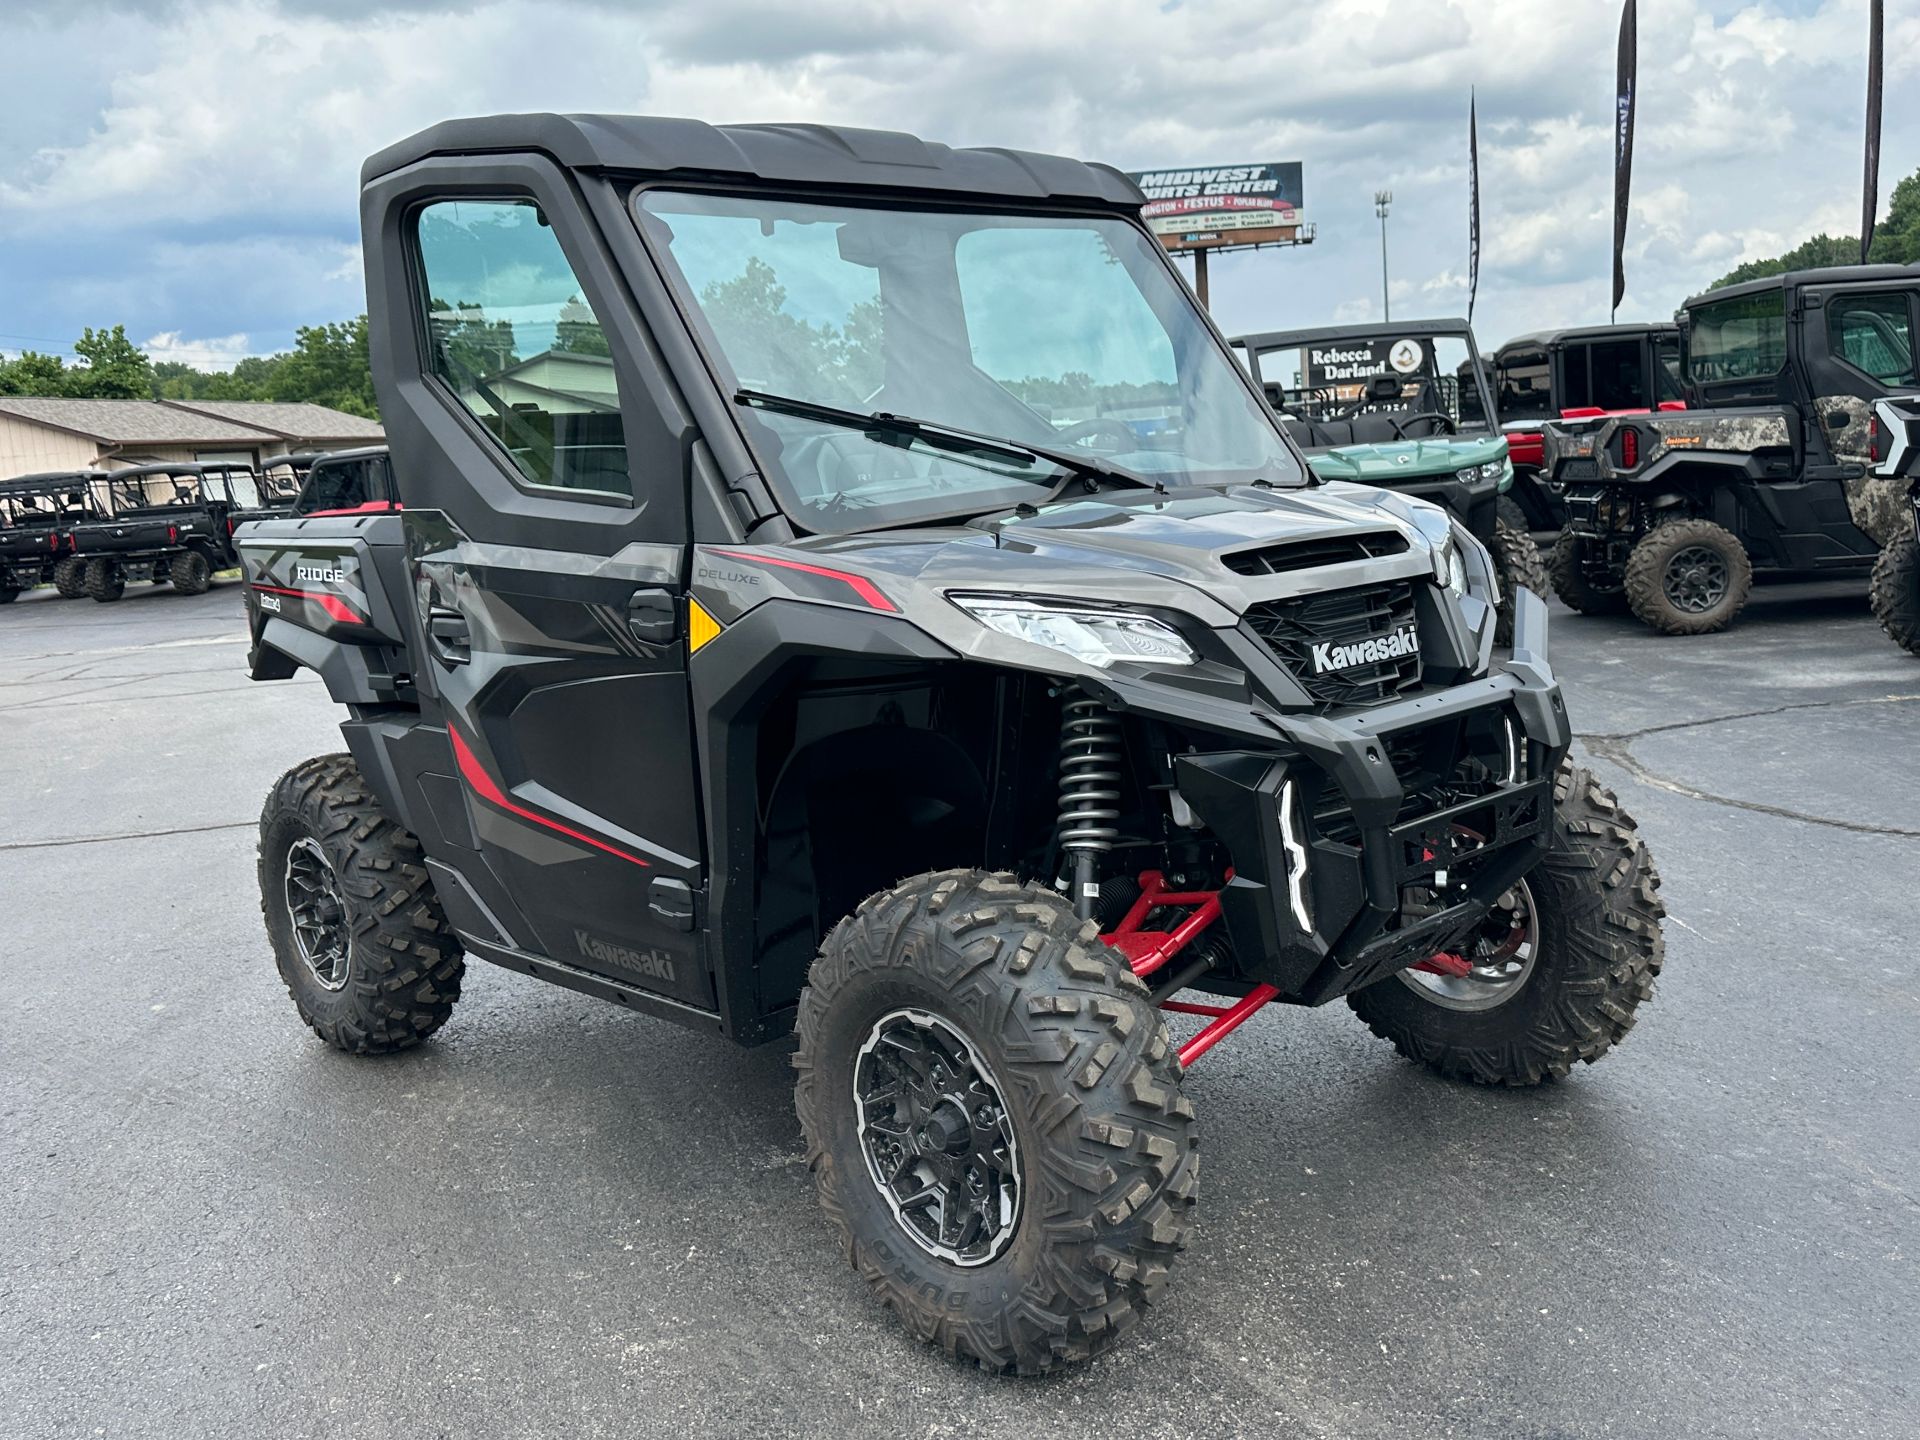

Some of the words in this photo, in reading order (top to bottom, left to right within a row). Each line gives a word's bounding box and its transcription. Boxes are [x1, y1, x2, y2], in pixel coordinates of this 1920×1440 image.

[1139, 166, 1266, 188] MIDWEST
[1204, 179, 1278, 196] CENTER
[1183, 196, 1224, 209] FESTUS
[1312, 348, 1372, 365] Rebecca
[1324, 361, 1386, 380] Darland
[297, 566, 344, 583] RIDGE
[698, 568, 760, 585] DELUXE
[1312, 625, 1419, 674] Kawasaki
[573, 929, 676, 982] Kawasaki
